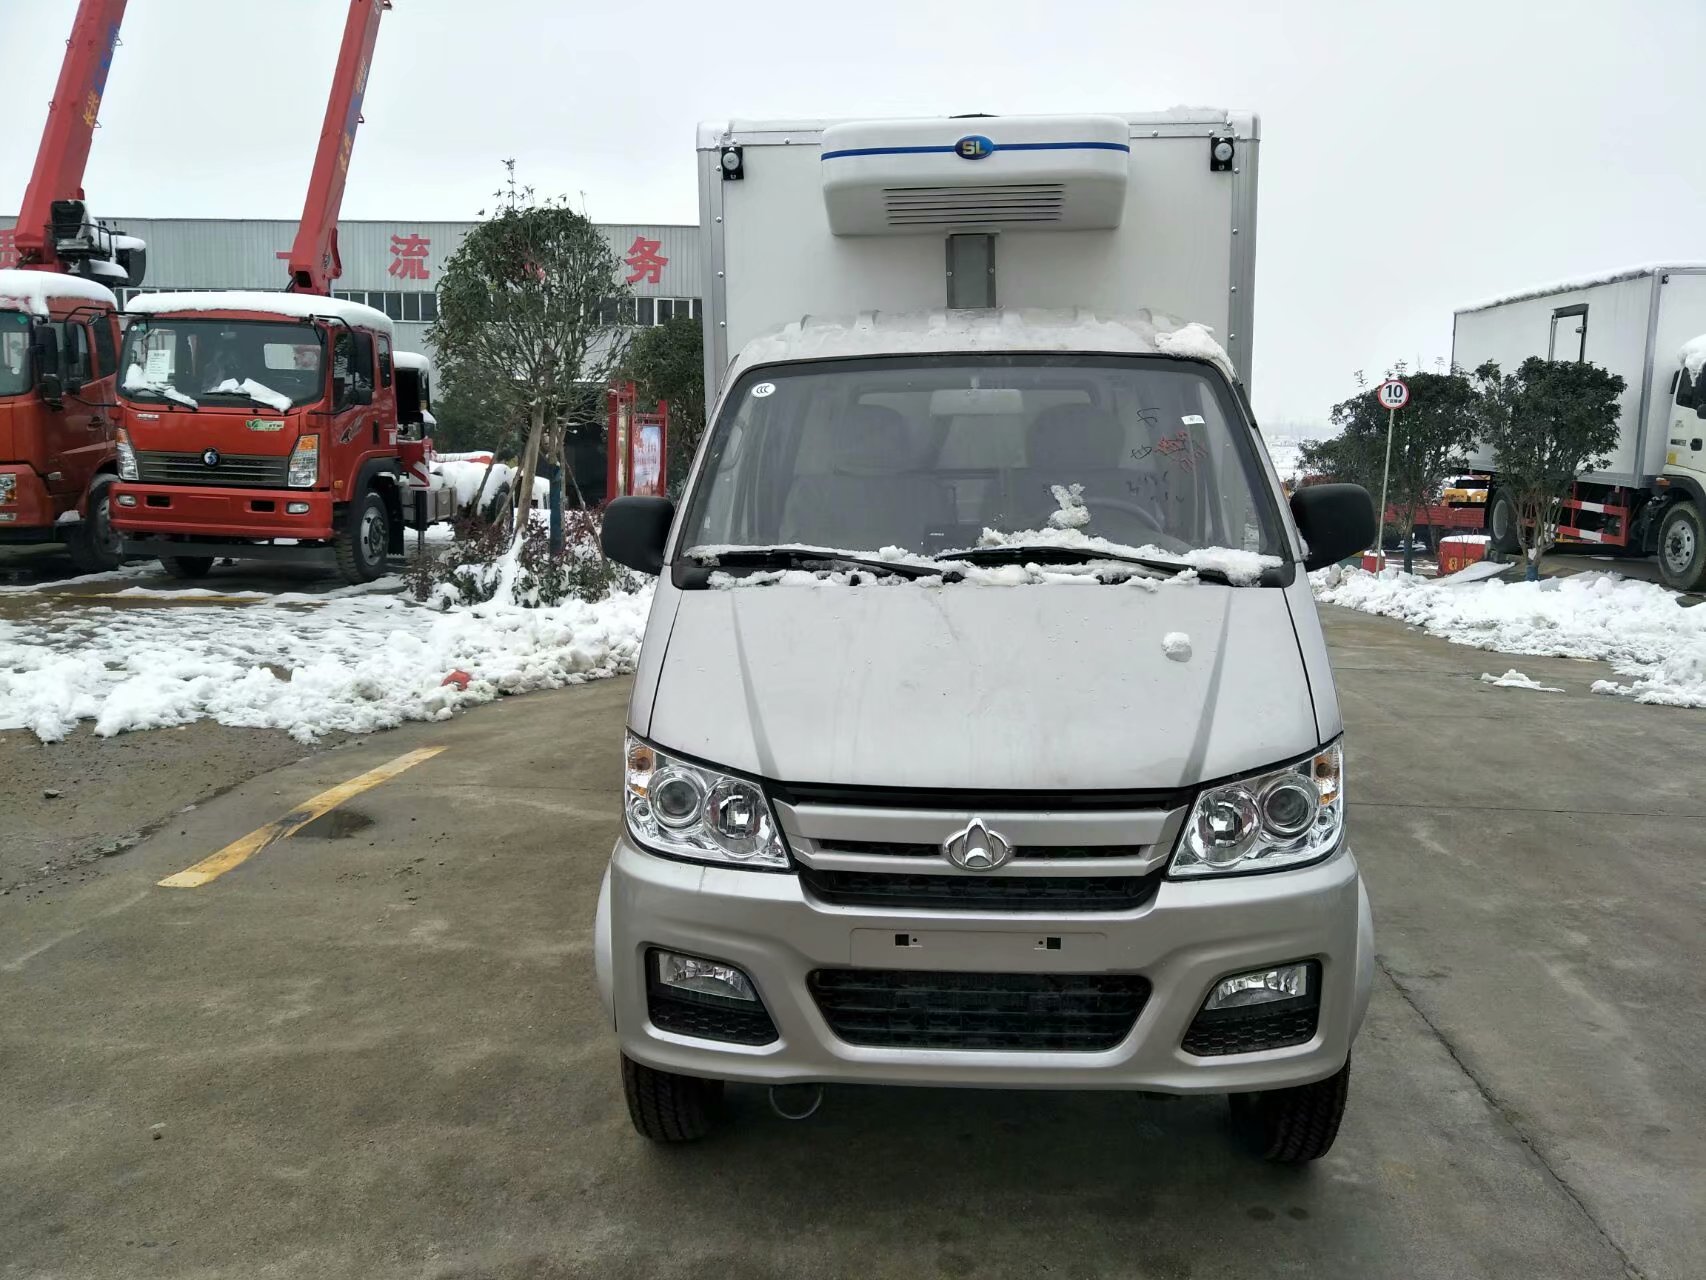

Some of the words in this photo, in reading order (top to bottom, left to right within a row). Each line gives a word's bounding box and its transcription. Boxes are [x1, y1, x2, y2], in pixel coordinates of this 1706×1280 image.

[962, 140, 987, 155] SL
[388, 233, 431, 280] 流
[624, 236, 669, 284] 务
[1385, 384, 1404, 398] 10
